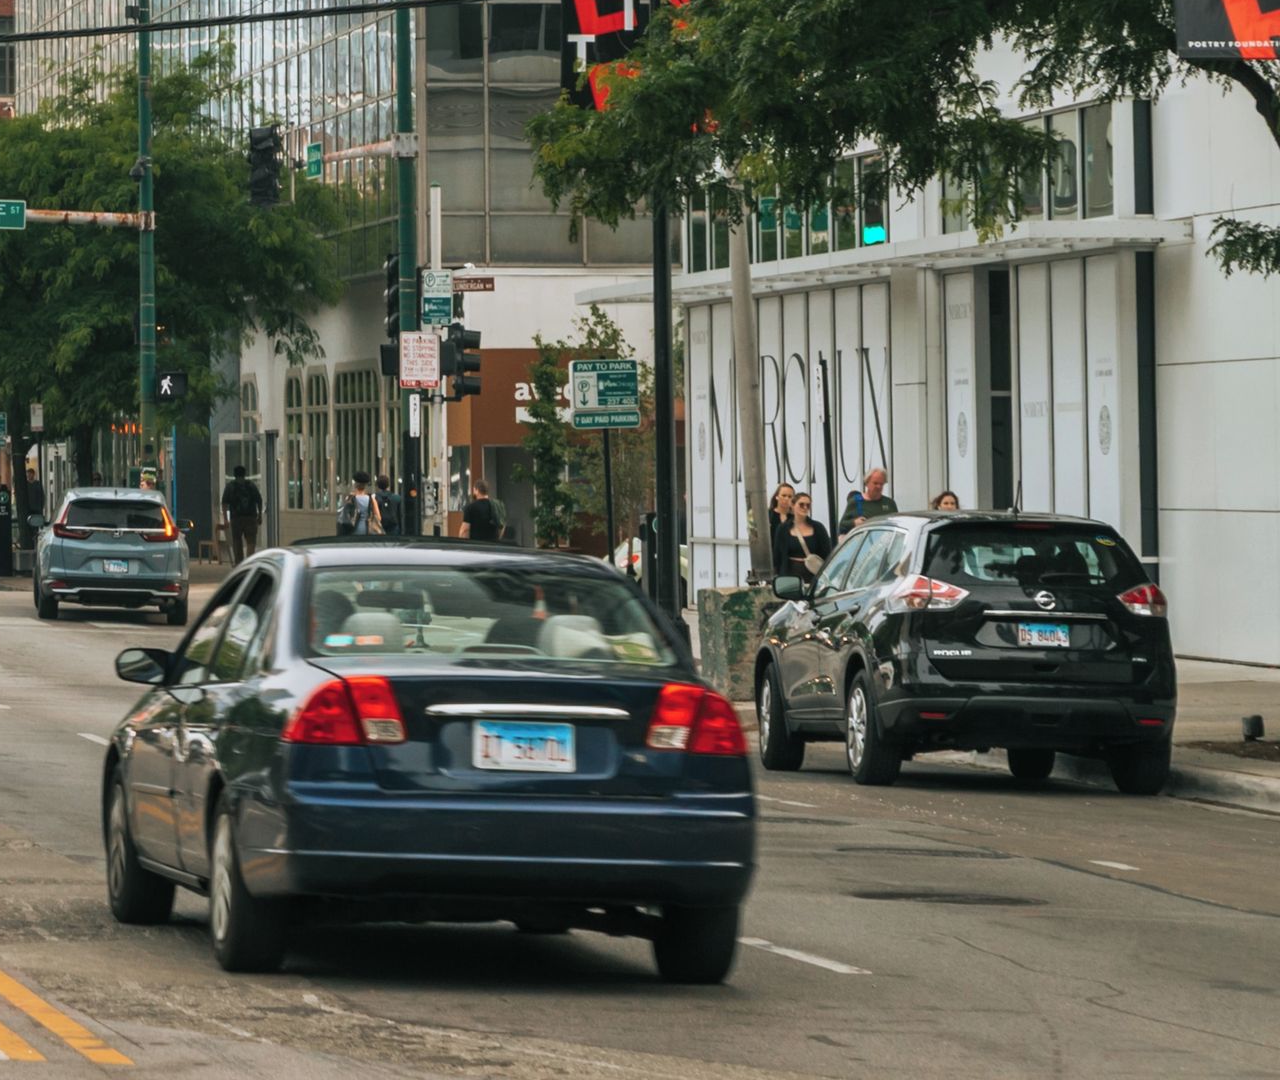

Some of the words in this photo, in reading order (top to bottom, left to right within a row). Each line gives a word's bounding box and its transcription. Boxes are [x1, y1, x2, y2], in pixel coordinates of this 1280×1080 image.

[10, 206, 20, 214] ST
[577, 363, 593, 371] PAY
[609, 362, 632, 370] PARK
[611, 415, 638, 423] PARKING
